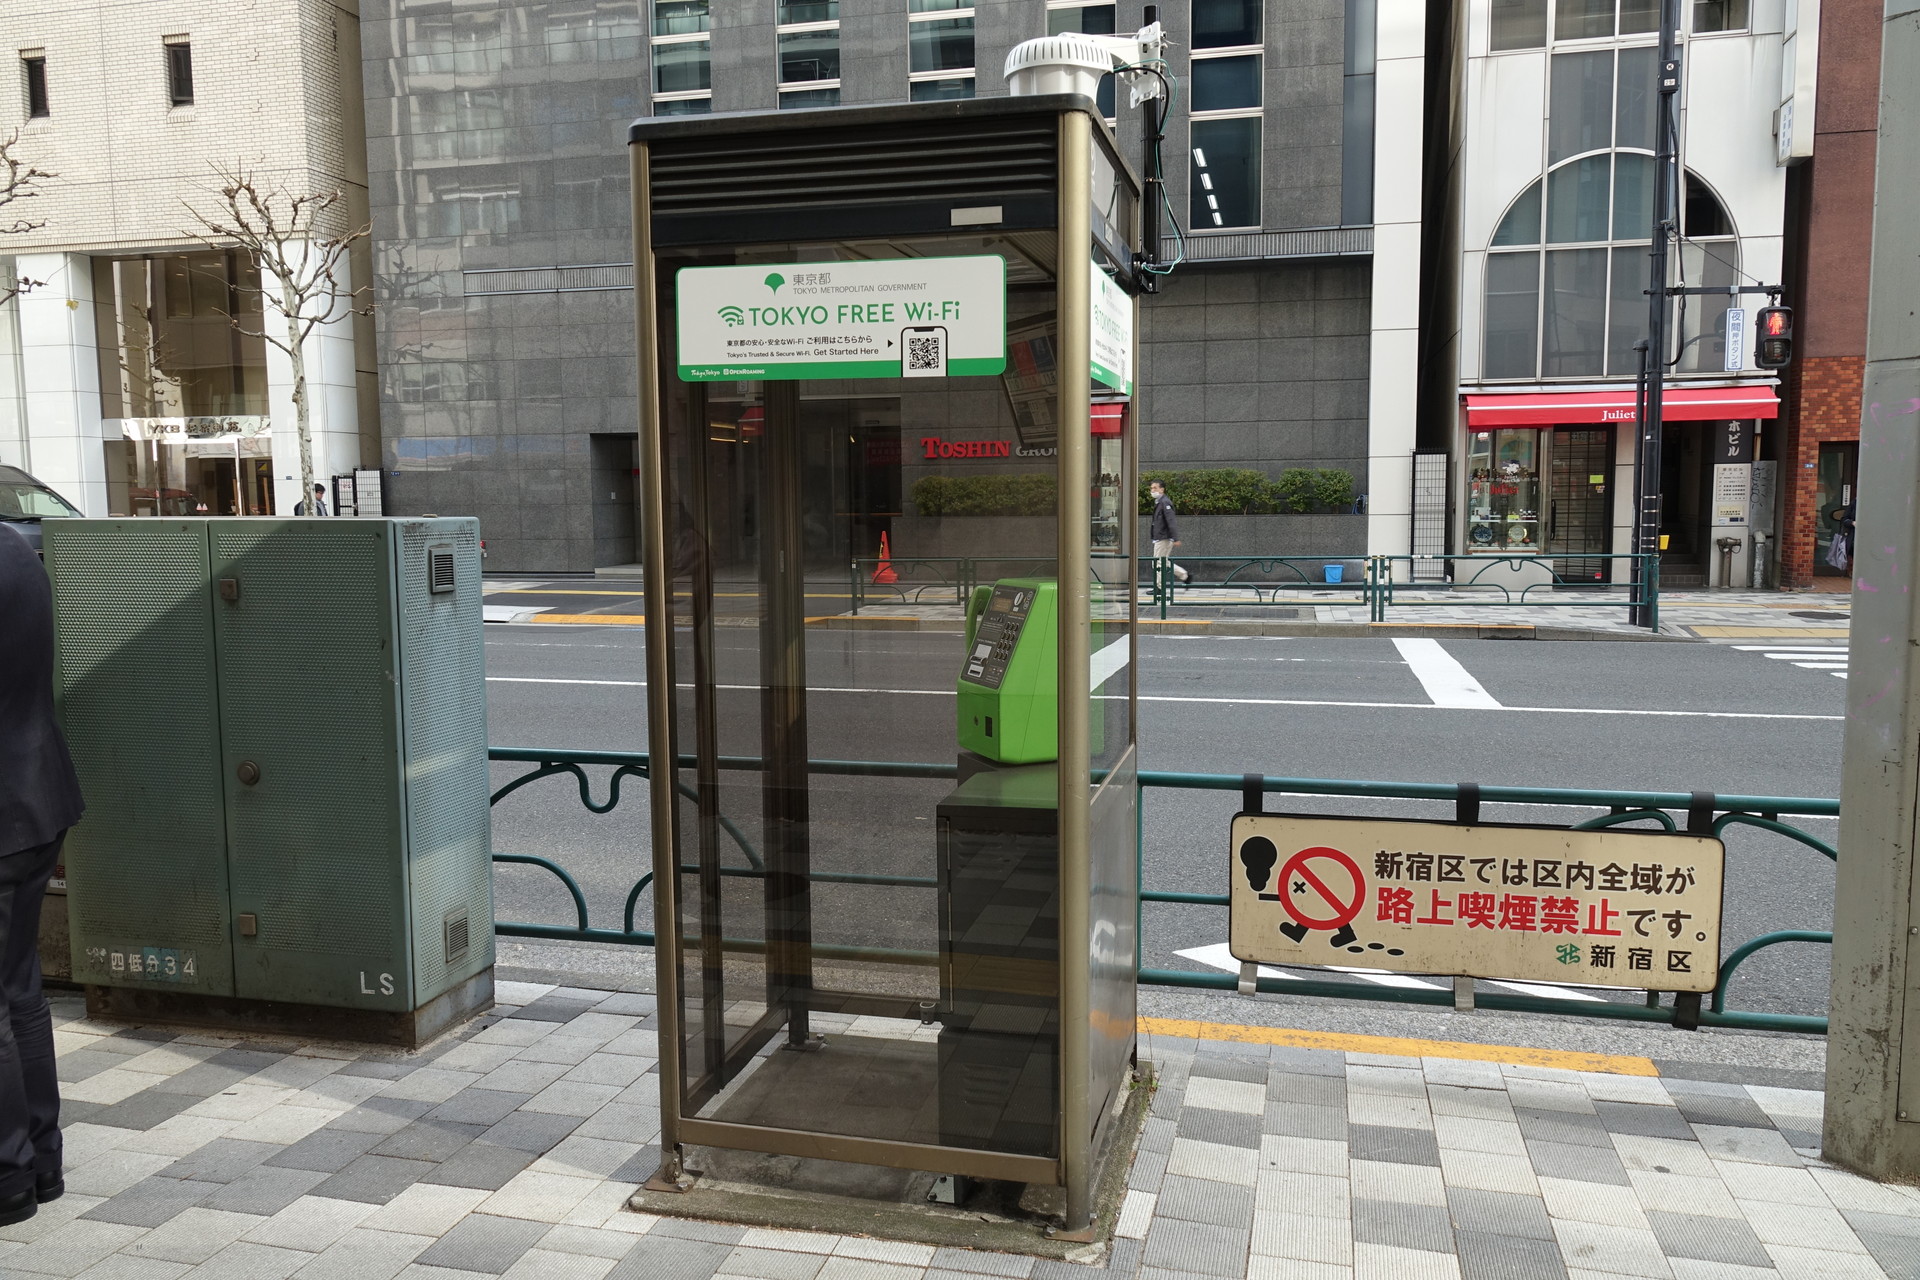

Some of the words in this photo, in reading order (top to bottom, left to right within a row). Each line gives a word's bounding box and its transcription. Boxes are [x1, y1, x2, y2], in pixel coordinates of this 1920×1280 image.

[793, 272, 832, 286] 東京都
[793, 287, 818, 295] TOKYO
[820, 285, 875, 294] METROPOLITAN
[877, 282, 928, 292] GOVERNMENT
[748, 305, 829, 327] TOKYO
[837, 303, 895, 324] FREE
[904, 301, 960, 322] Wi-Fi
[806, 336, 873, 345] ご利用はこちらから
[727, 351, 748, 359] Tokyo's
[813, 348, 827, 356] Get
[829, 347, 858, 356] Started
[860, 347, 879, 355] Here
[1602, 410, 1636, 421] Juliet
[920, 437, 1012, 459] TOSHIN
[1374, 850, 1697, 897] 新宿区では区内全域が
[1376, 886, 1707, 944] 路上喫煙禁止です。
[1589, 943, 1692, 974] 新宿区
[360, 971, 395, 996] LS
